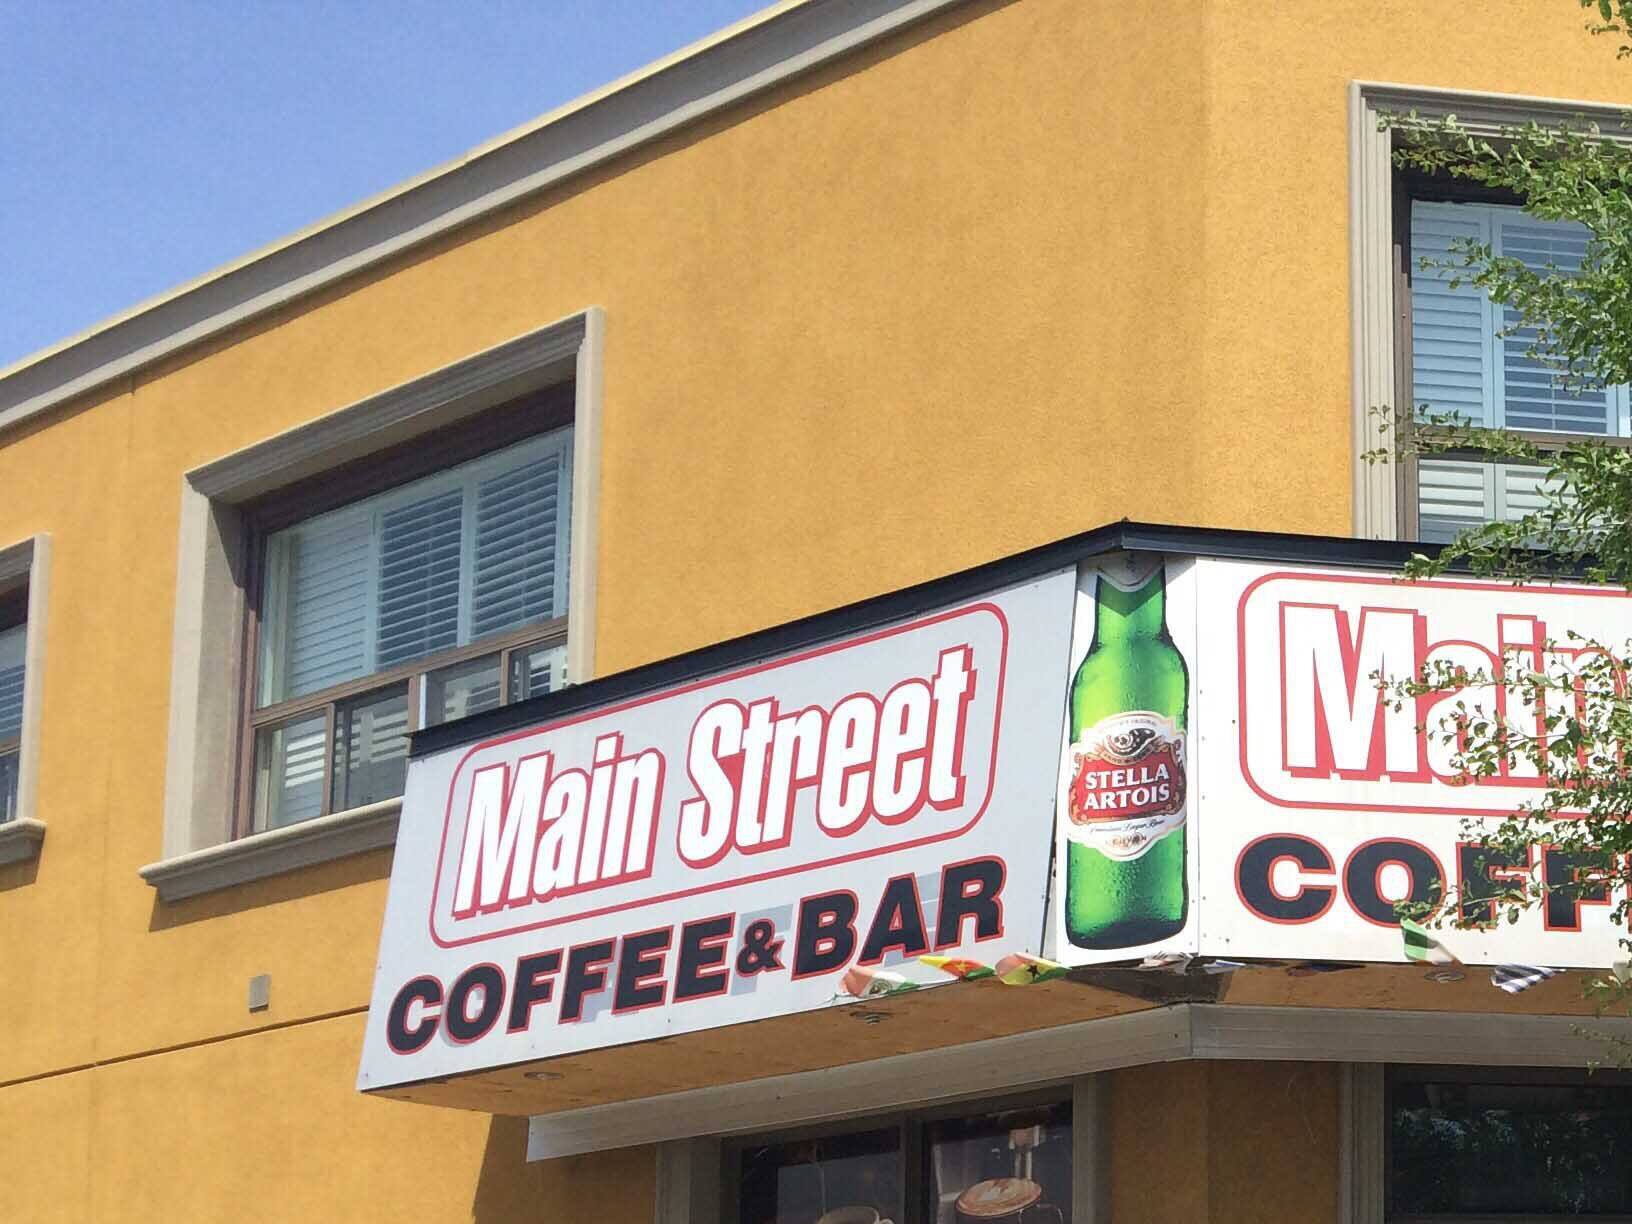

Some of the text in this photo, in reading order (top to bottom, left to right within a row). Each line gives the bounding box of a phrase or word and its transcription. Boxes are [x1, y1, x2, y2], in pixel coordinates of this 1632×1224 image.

[1279, 601, 1630, 788] Main
[453, 644, 977, 921] Main Street
[1084, 783, 1169, 810] ARTOIS
[1085, 764, 1169, 790] STELLA
